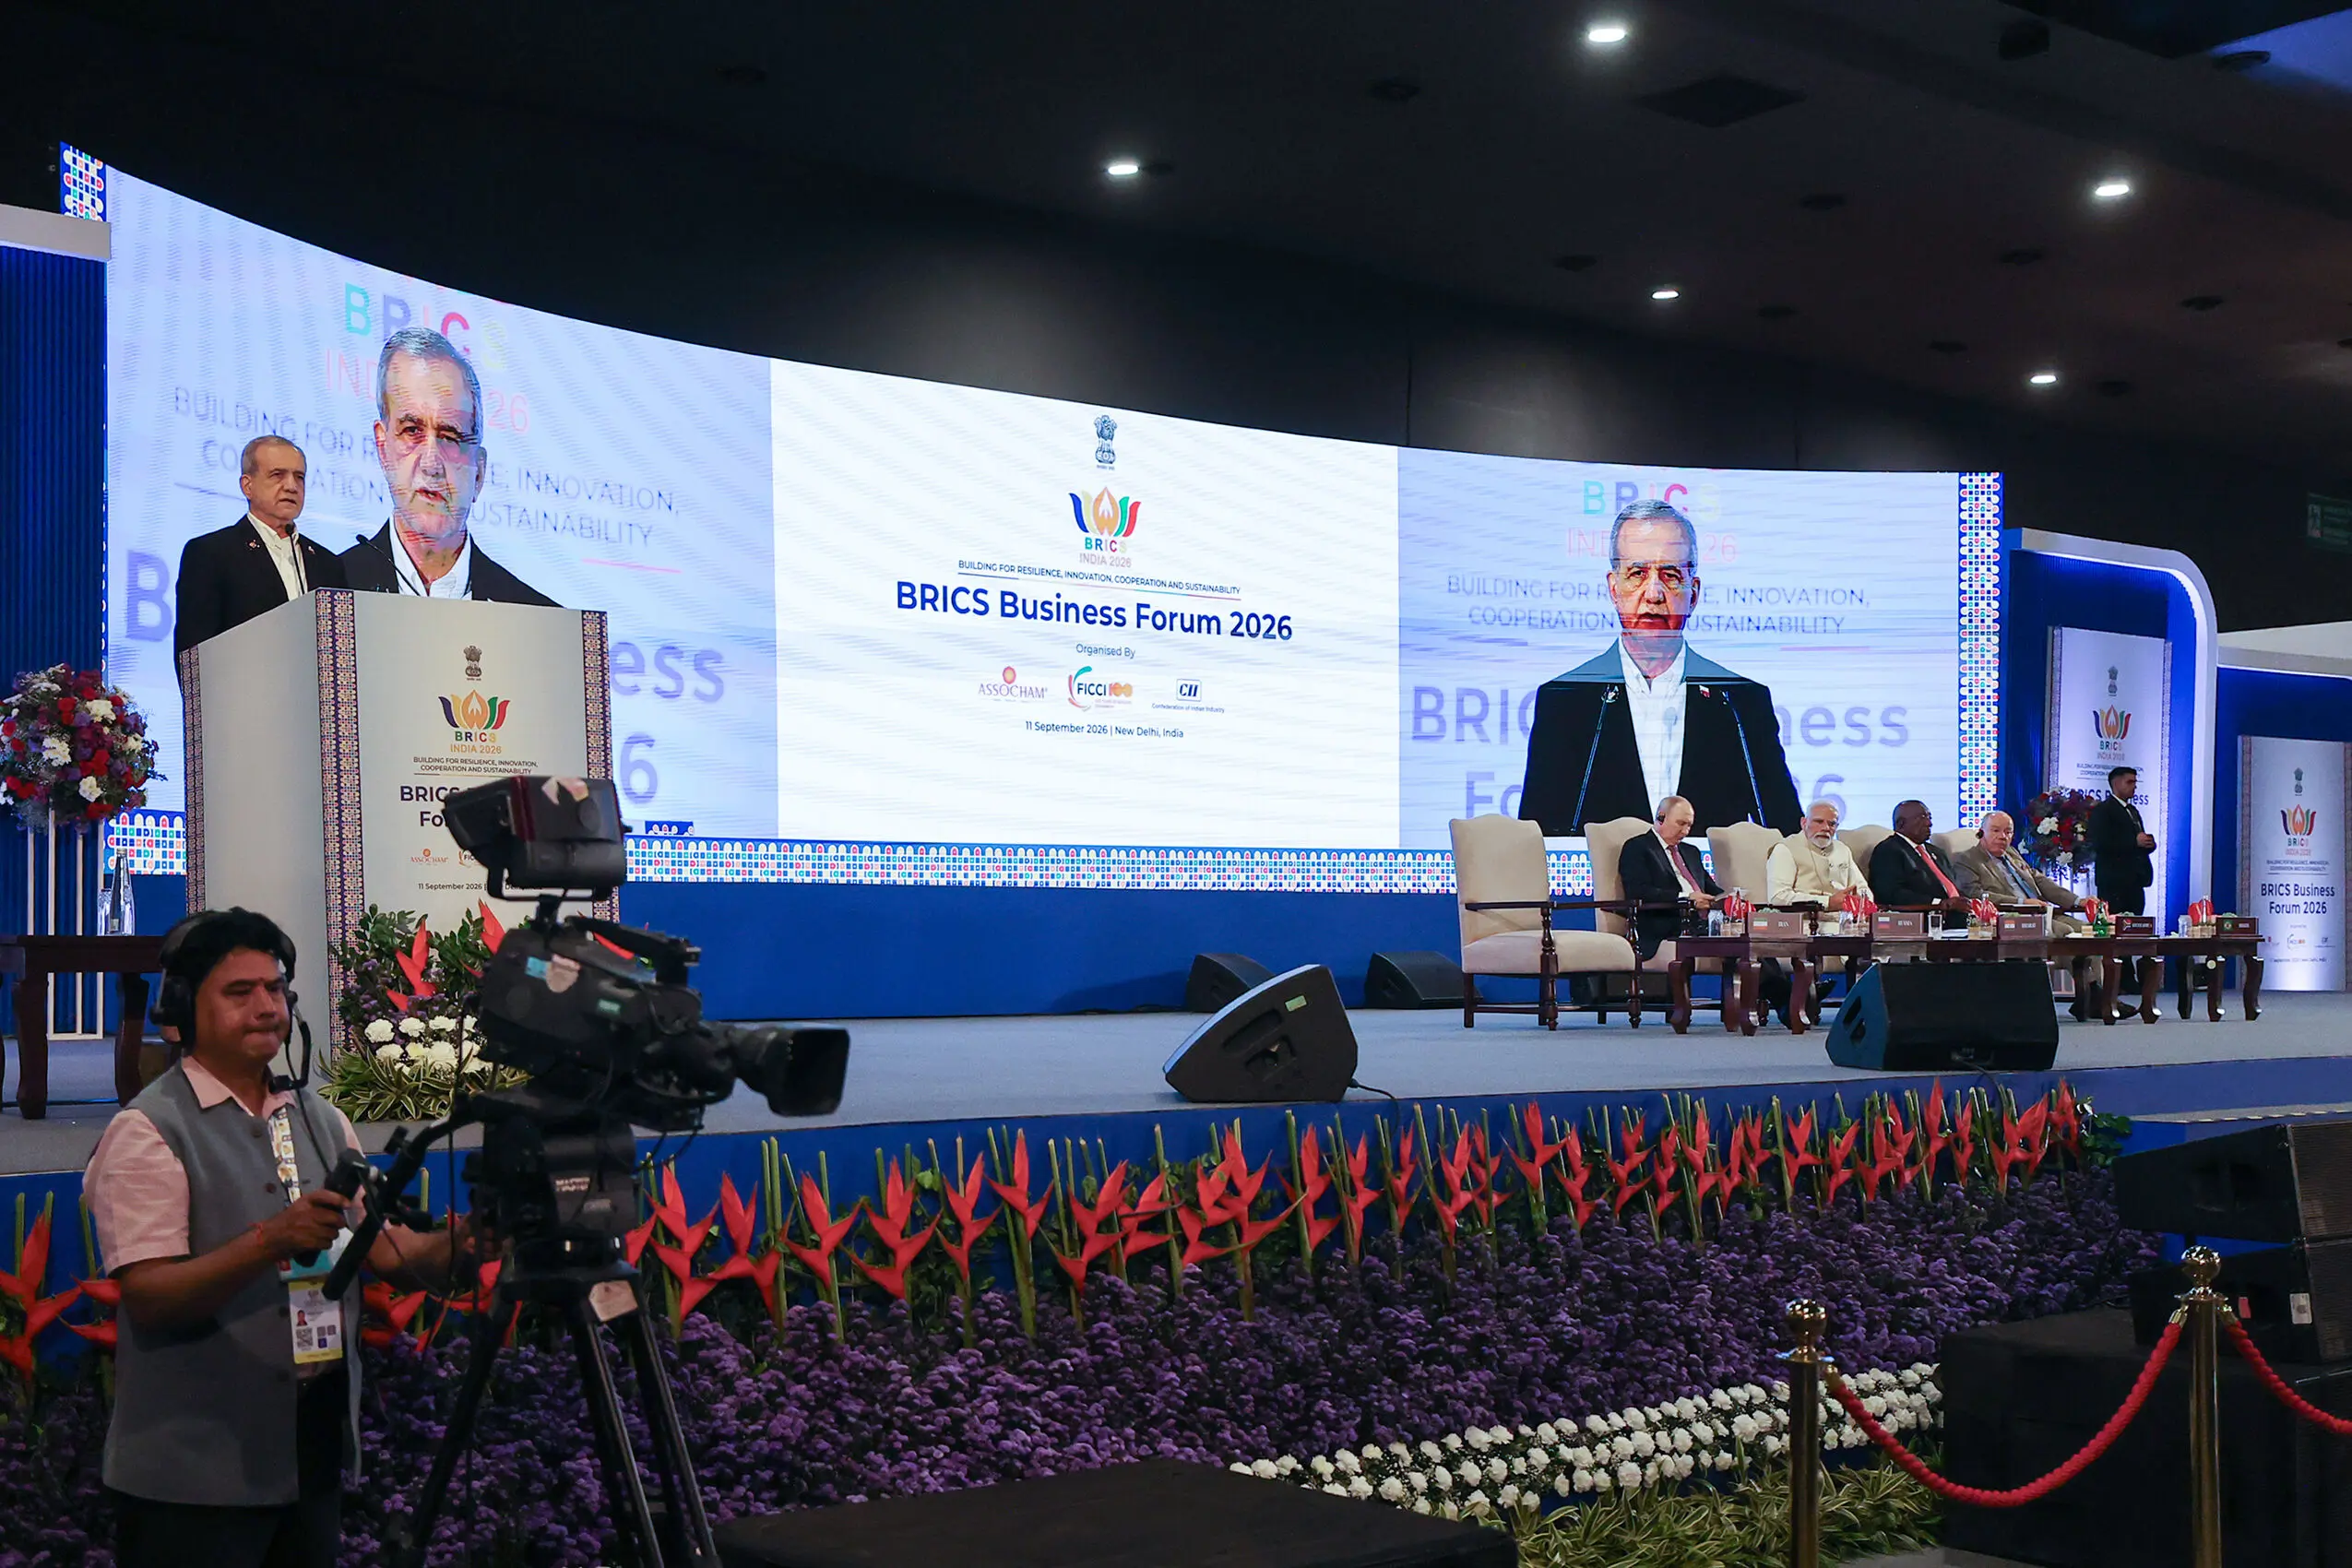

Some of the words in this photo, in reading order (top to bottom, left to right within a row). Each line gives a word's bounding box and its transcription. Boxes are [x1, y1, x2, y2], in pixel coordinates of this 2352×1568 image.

[173, 386, 297, 443] BUILDING
[304, 421, 354, 458] FOR
[202, 440, 386, 504] COATION
[517, 467, 680, 516] INNOVATION,
[471, 501, 654, 548] USTAINABILITY
[1084, 537, 1127, 553] BRICS
[1079, 552, 1108, 566] INDIA
[1110, 555, 1133, 569] 2026
[958, 559, 998, 573] BUILDING
[999, 564, 1016, 574] FOR
[1017, 565, 1063, 579] RESILIENCE,
[1114, 575, 1167, 589] COOPERATION
[1168, 579, 1184, 590] AND
[1185, 583, 1241, 595] SUSTAINABILITY
[1447, 575, 1543, 599] BUILDING
[1550, 580, 1590, 600] FOR
[1727, 587, 1871, 609] INNOVATION,
[897, 581, 990, 616] BRICS
[1000, 590, 1127, 628] Business
[1135, 602, 1222, 636] Forum
[1229, 611, 1293, 641] 2026
[1467, 605, 1615, 632] COOPERATION
[1685, 614, 1846, 635] USTAINABILITY
[1075, 643, 1123, 657] Organised
[1124, 647, 1136, 659] By
[1076, 683, 1107, 696] FICCI
[1179, 683, 1199, 698] CII
[1412, 685, 1538, 745] BRI
[455, 731, 497, 743] BRICS
[1025, 720, 1033, 731] 11
[1034, 721, 1085, 733] September
[1087, 724, 1109, 734] 2026
[1114, 726, 1135, 736] New
[1136, 727, 1162, 738] Delhi,
[1162, 728, 1184, 738] India
[450, 744, 477, 754] INDIA
[480, 744, 502, 754] 2026
[413, 756, 445, 765] BUILDING
[459, 758, 497, 767] RESILIENCE,
[421, 765, 467, 773] COOPERATION
[483, 766, 532, 776] SUSTAINABILITY
[425, 883, 464, 892] September
[2261, 883, 2291, 897] BRICS
[2293, 883, 2335, 897] Business
[2269, 901, 2300, 914] Forum
[2303, 901, 2327, 914] 2026
